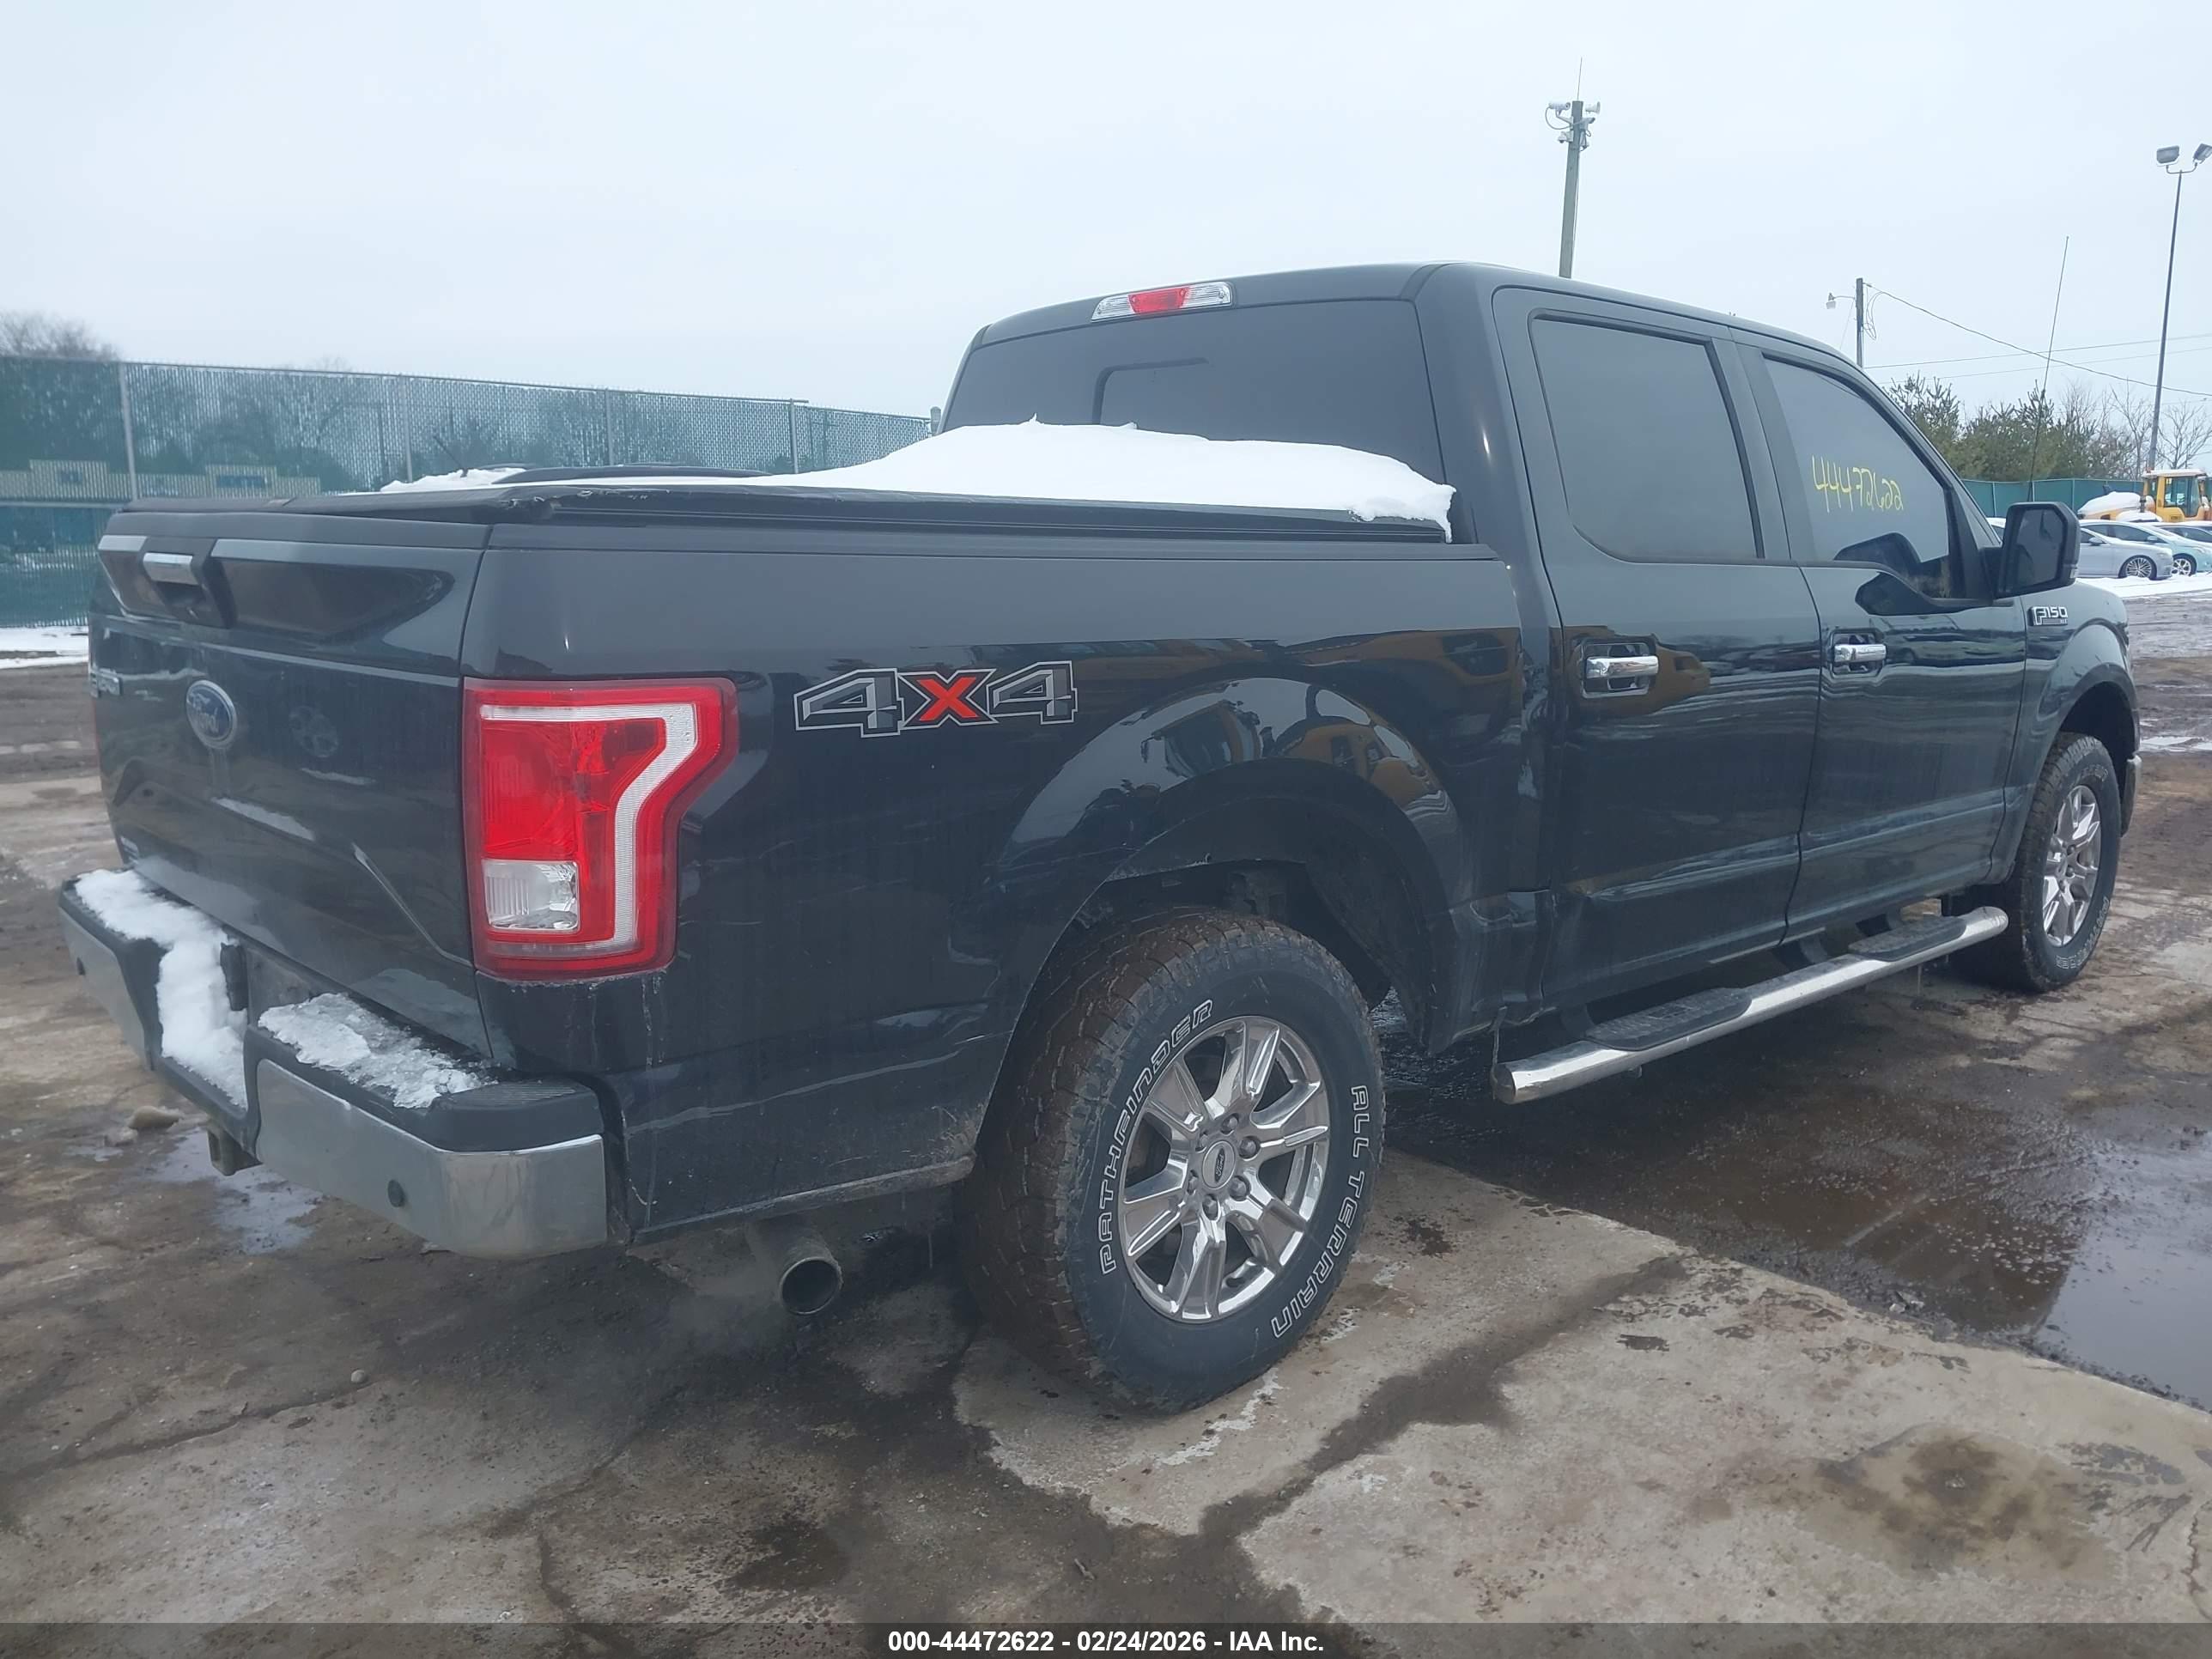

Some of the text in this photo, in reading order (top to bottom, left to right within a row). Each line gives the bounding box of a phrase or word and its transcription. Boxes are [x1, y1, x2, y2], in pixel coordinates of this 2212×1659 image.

[1811, 455, 1904, 514] 44472622
[1098, 1000, 1212, 1274] PATHFINDER
[1271, 1085, 1370, 1338] ALL TERRAIN
